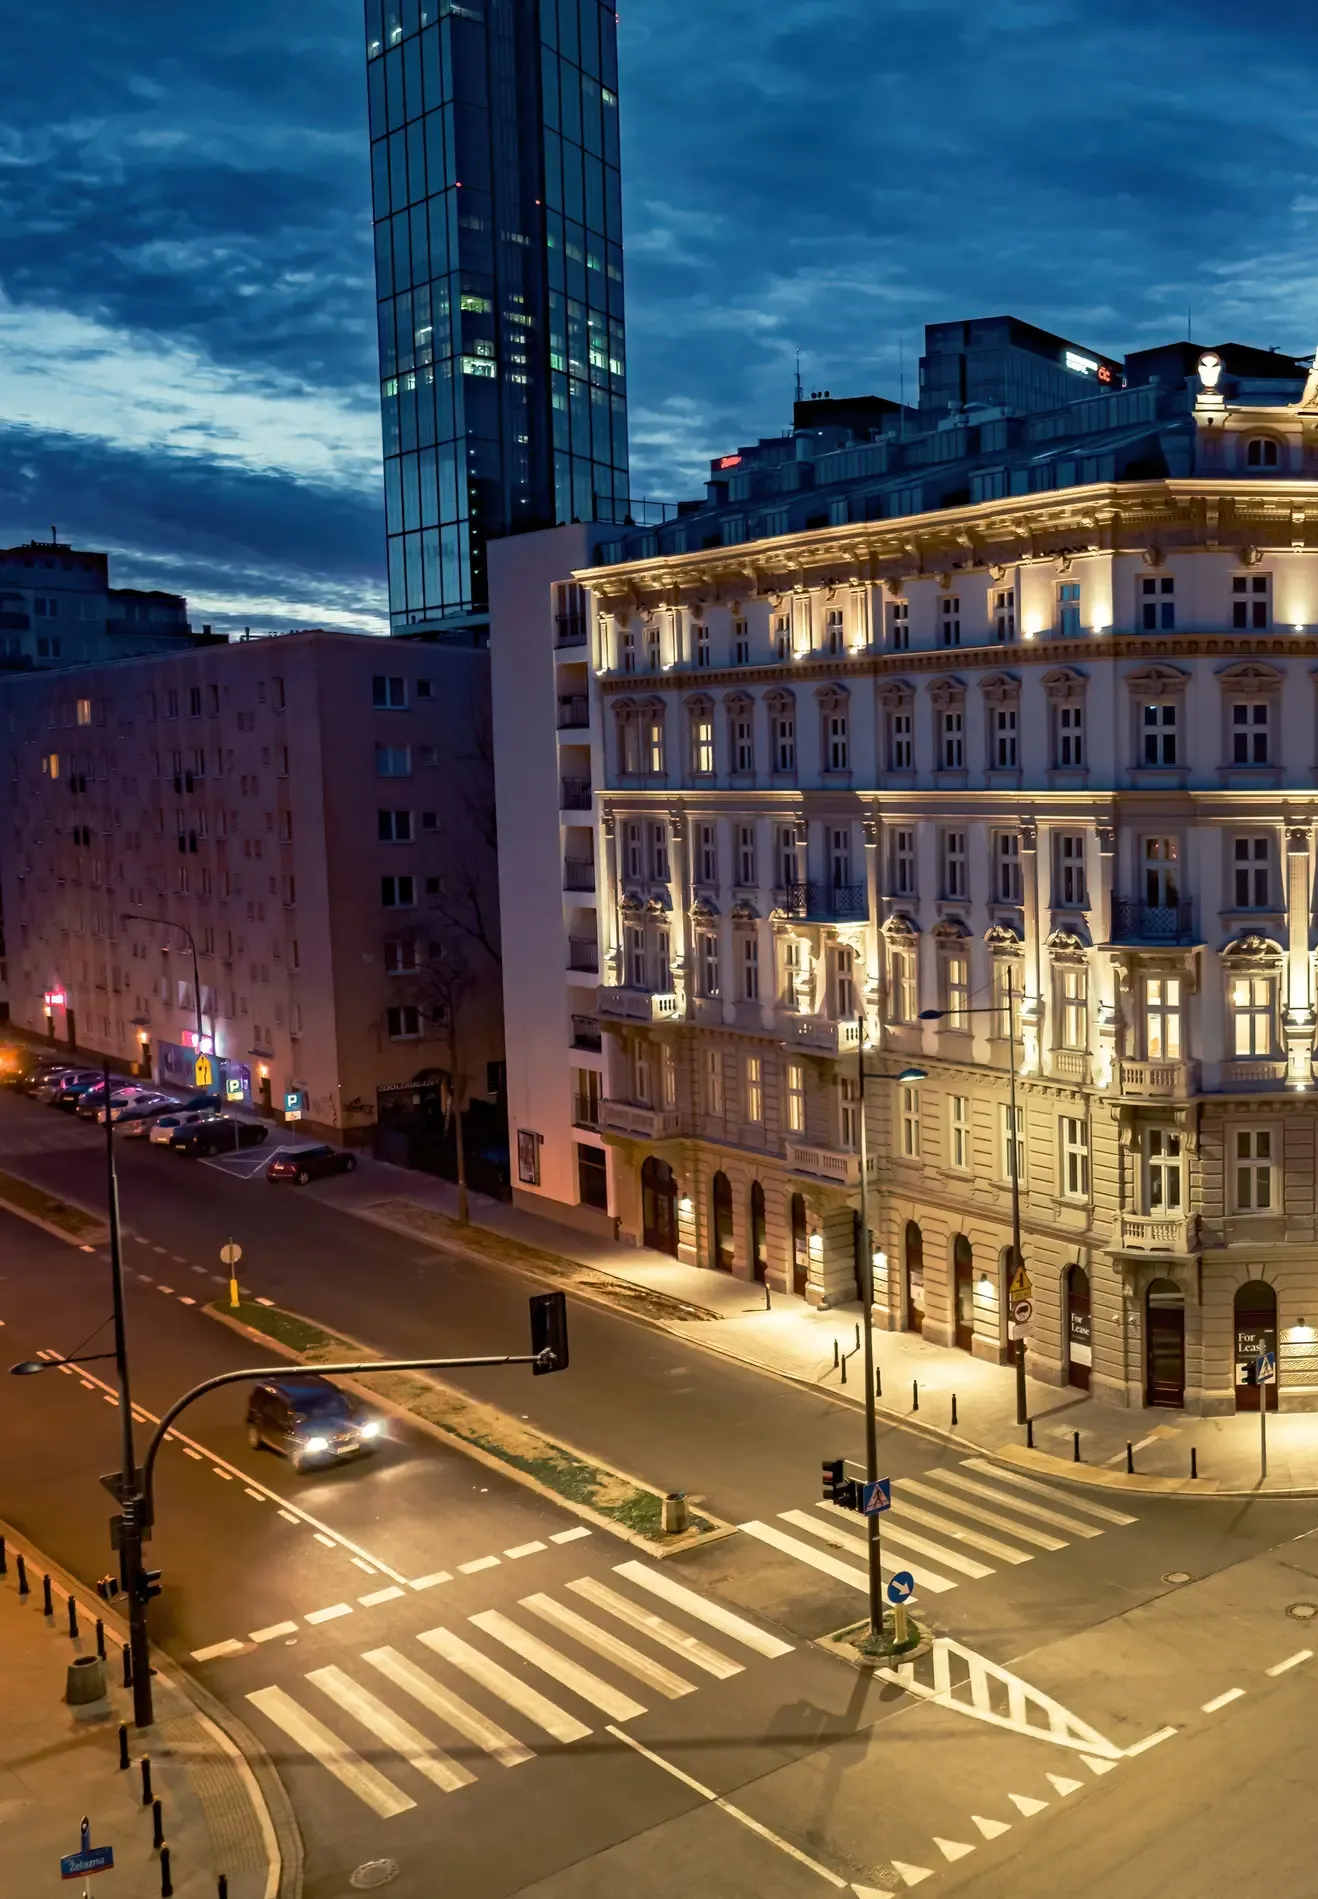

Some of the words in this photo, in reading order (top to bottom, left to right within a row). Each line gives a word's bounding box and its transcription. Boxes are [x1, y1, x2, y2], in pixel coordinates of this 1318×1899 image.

[229, 1080, 239, 1092] P
[287, 1094, 297, 1107] P
[1071, 1312, 1083, 1323] For
[1071, 1322, 1090, 1336] Lease
[1238, 1332, 1256, 1342] For
[68, 1857, 105, 1872] Żelazna
